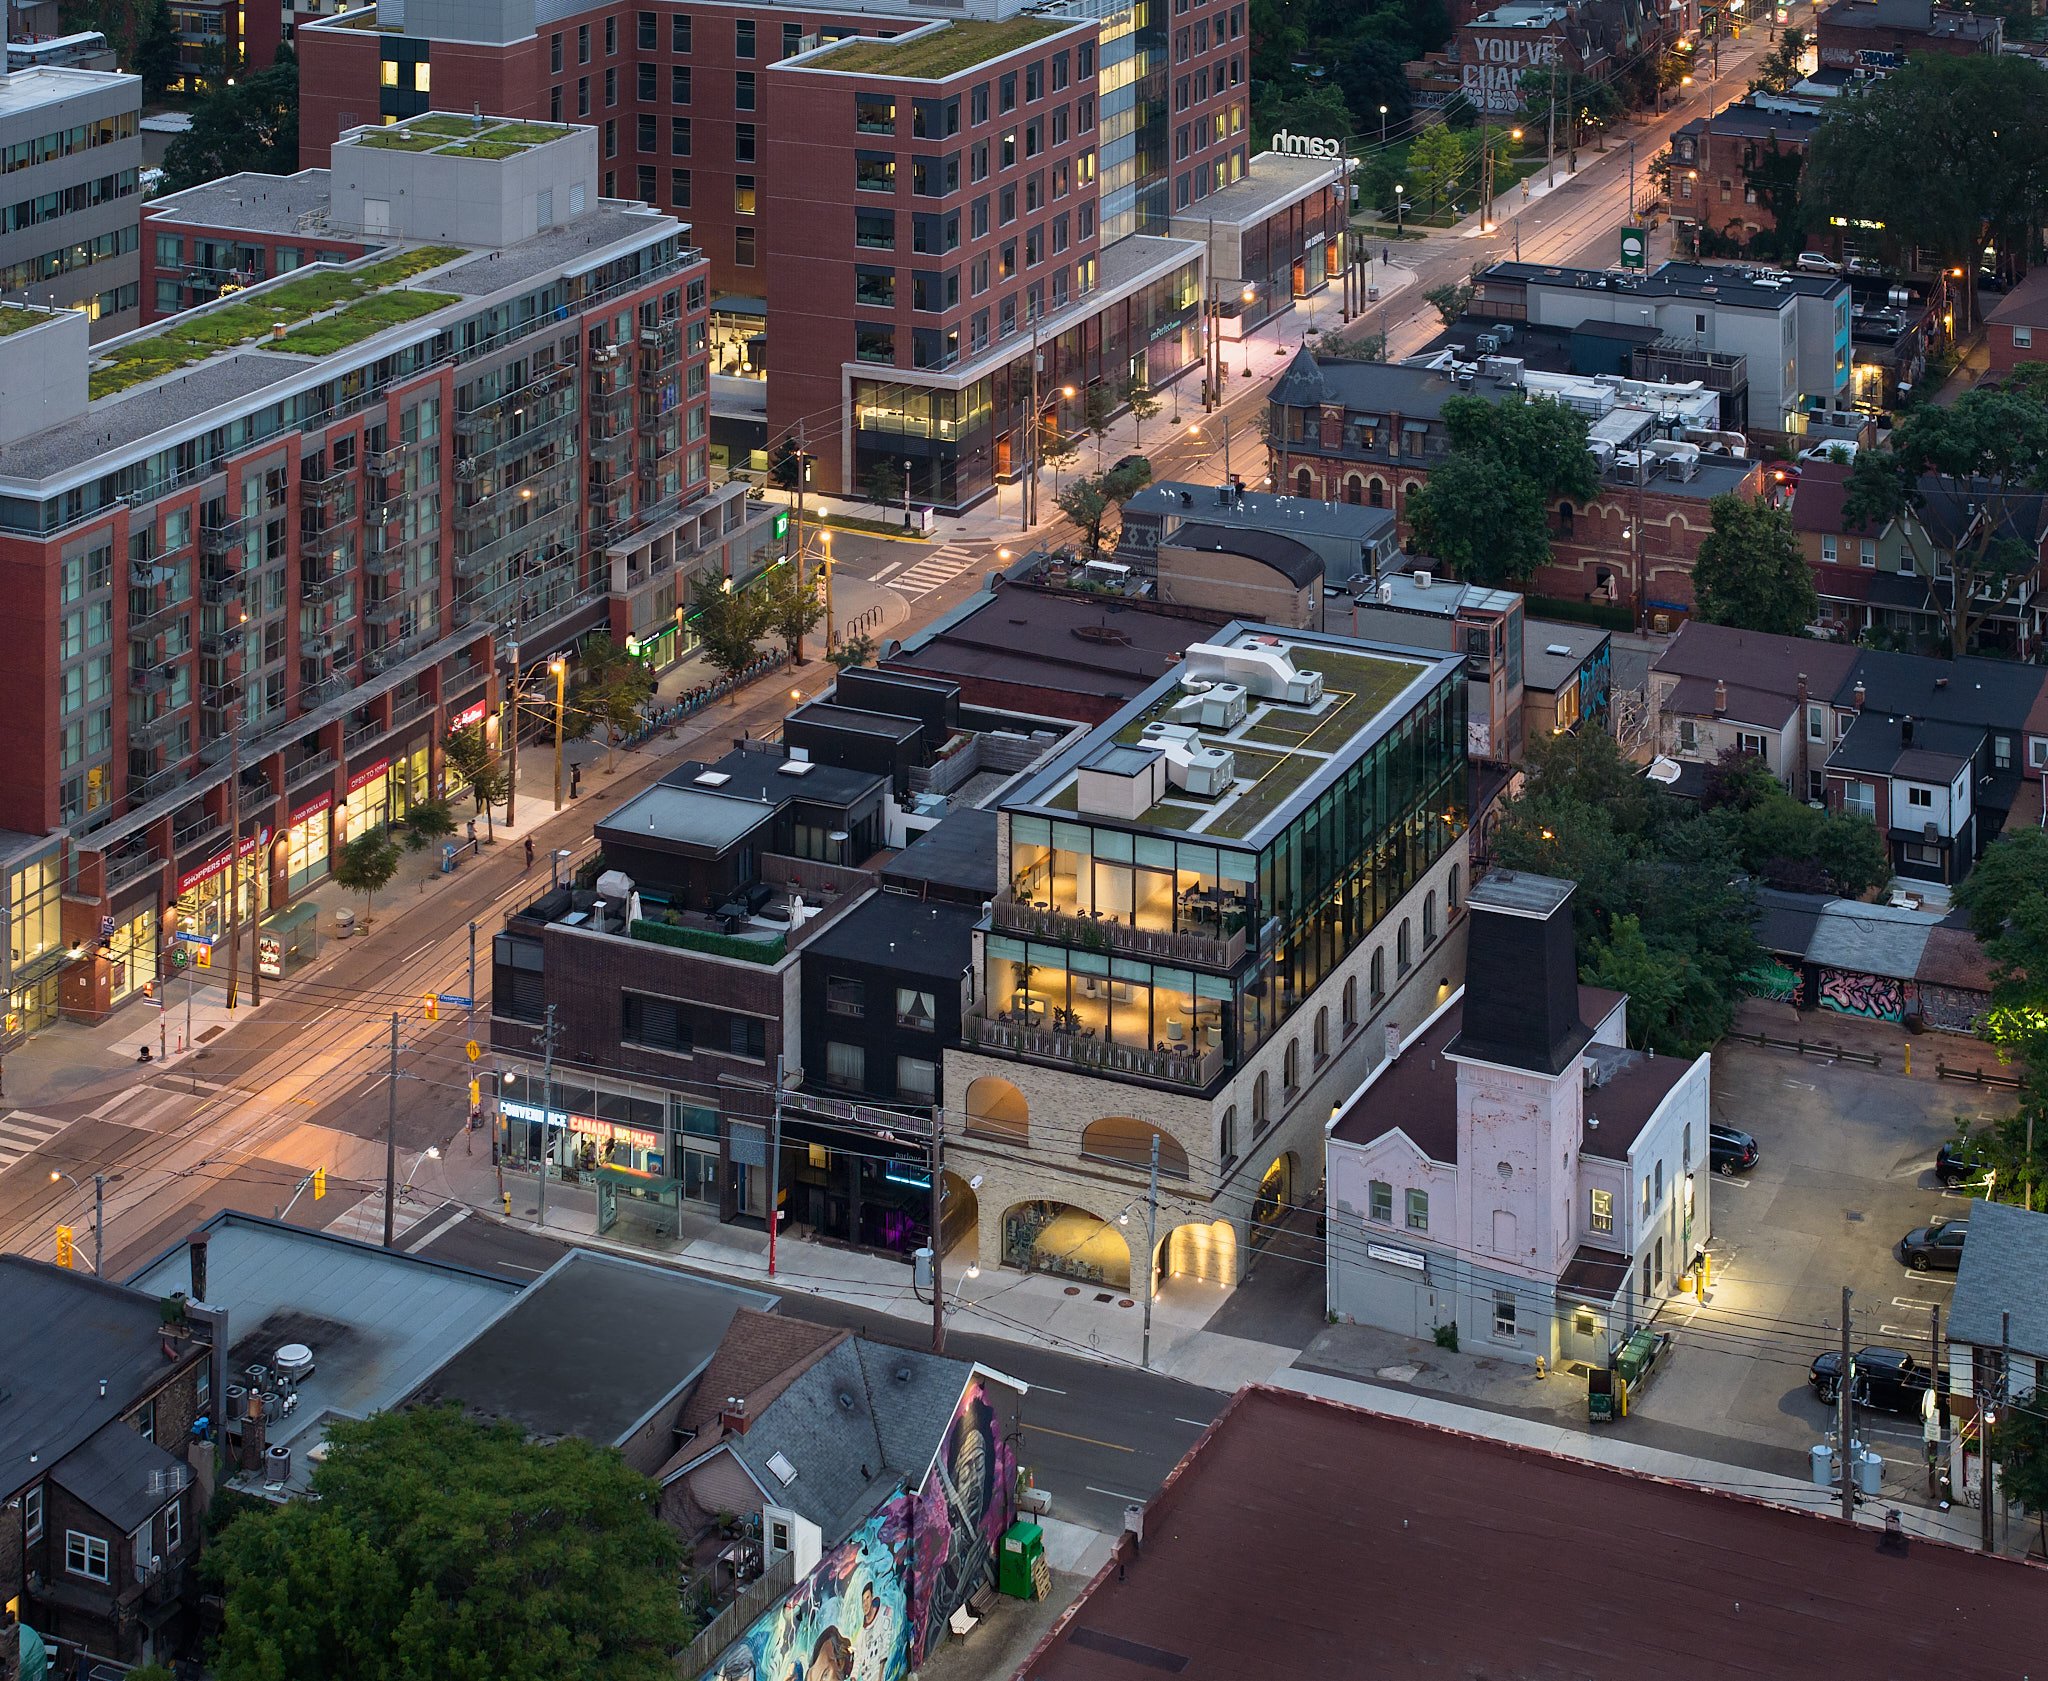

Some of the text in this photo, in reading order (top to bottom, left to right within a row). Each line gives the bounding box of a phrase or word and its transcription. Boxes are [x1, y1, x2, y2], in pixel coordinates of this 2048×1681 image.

[1474, 37, 1554, 66] YOU'VE
[1463, 64, 1527, 92] CHAN
[1311, 230, 1326, 247] DENTAL
[777, 517, 787, 534] TD
[351, 774, 366, 788] OPEN
[294, 809, 307, 821] FOOD
[183, 840, 255, 887] SHOPPERS DR MAR
[500, 1101, 567, 1128] CONVENINCE
[570, 1116, 611, 1138] CANADA
[631, 1130, 656, 1146] PALACE
[1424, 1277, 1433, 1287] 16
